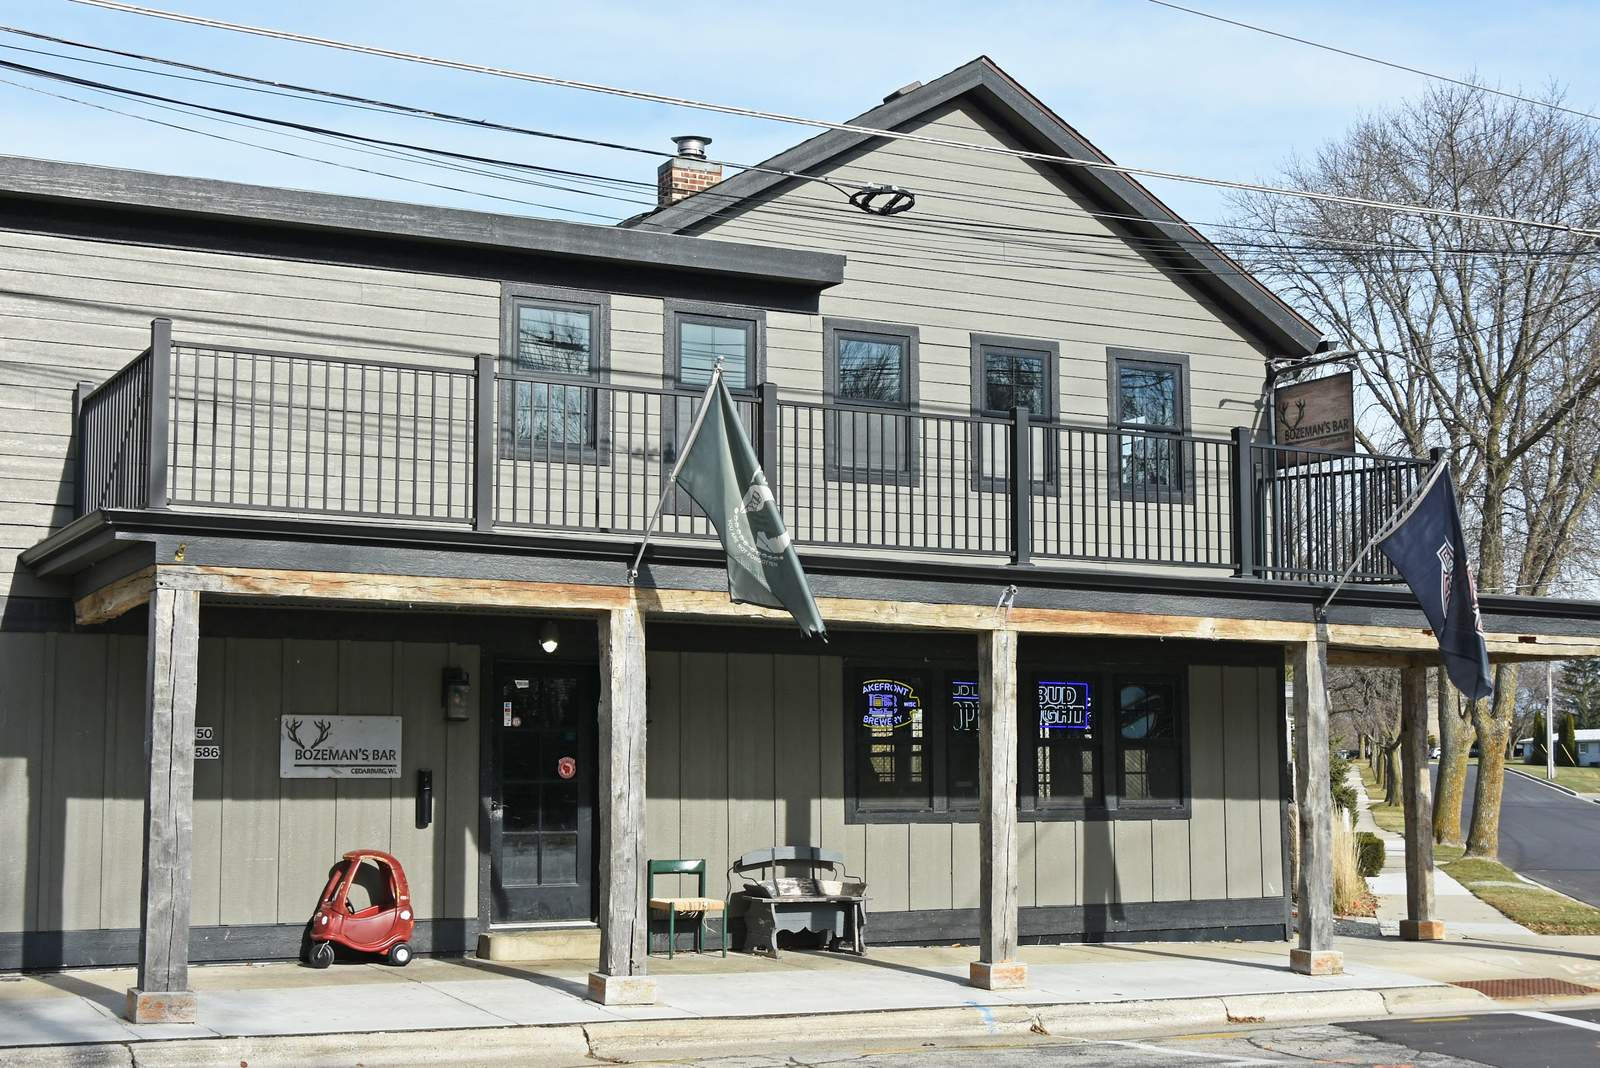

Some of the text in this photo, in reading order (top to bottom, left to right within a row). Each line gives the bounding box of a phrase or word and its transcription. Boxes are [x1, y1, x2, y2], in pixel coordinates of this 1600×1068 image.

[1284, 419, 1350, 441] BOZEMAN'S BAR
[862, 683, 909, 697] AKEFRONT
[1038, 686, 1077, 705] BUD
[863, 715, 903, 726] BREWERY
[1039, 704, 1085, 724] IGHT
[196, 728, 213, 739] 50
[194, 747, 219, 758] 586
[294, 748, 397, 761] BOZEMAN'S BAR
